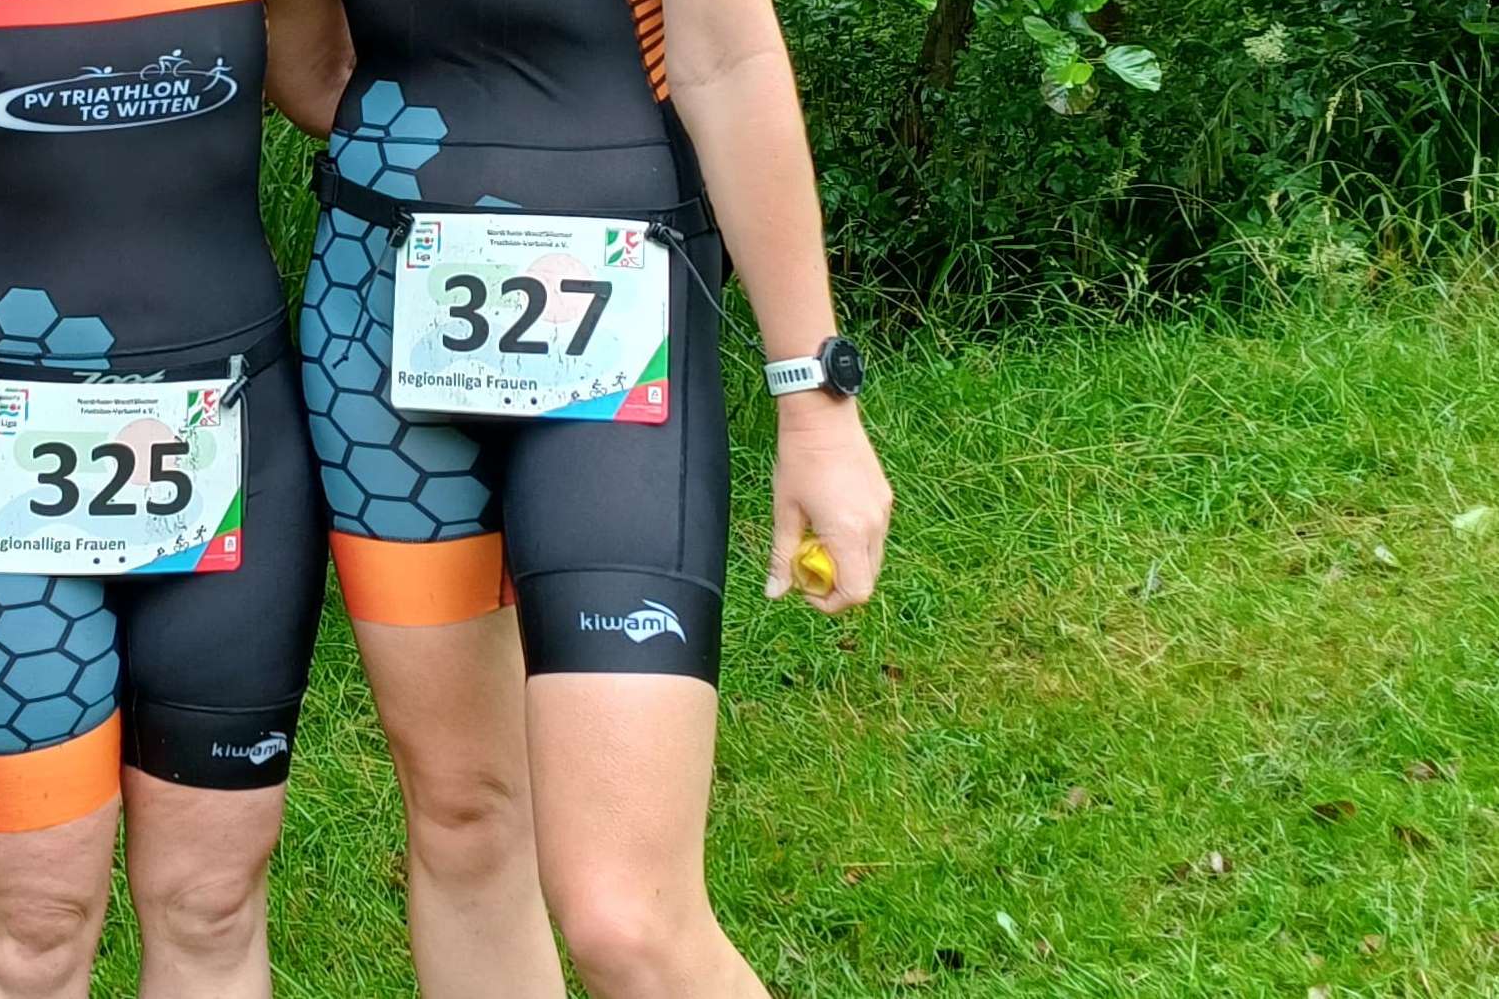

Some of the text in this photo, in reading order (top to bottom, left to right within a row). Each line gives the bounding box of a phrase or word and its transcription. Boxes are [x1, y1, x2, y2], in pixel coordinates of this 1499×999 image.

[23, 79, 191, 110] PV TRIATHLON
[79, 95, 201, 122] TG WITTEN
[442, 273, 613, 356] 327
[398, 371, 538, 392] Regionalliga Frauen
[29, 441, 193, 517] 325
[75, 537, 126, 551] Frauen
[580, 610, 670, 636] kiwami
